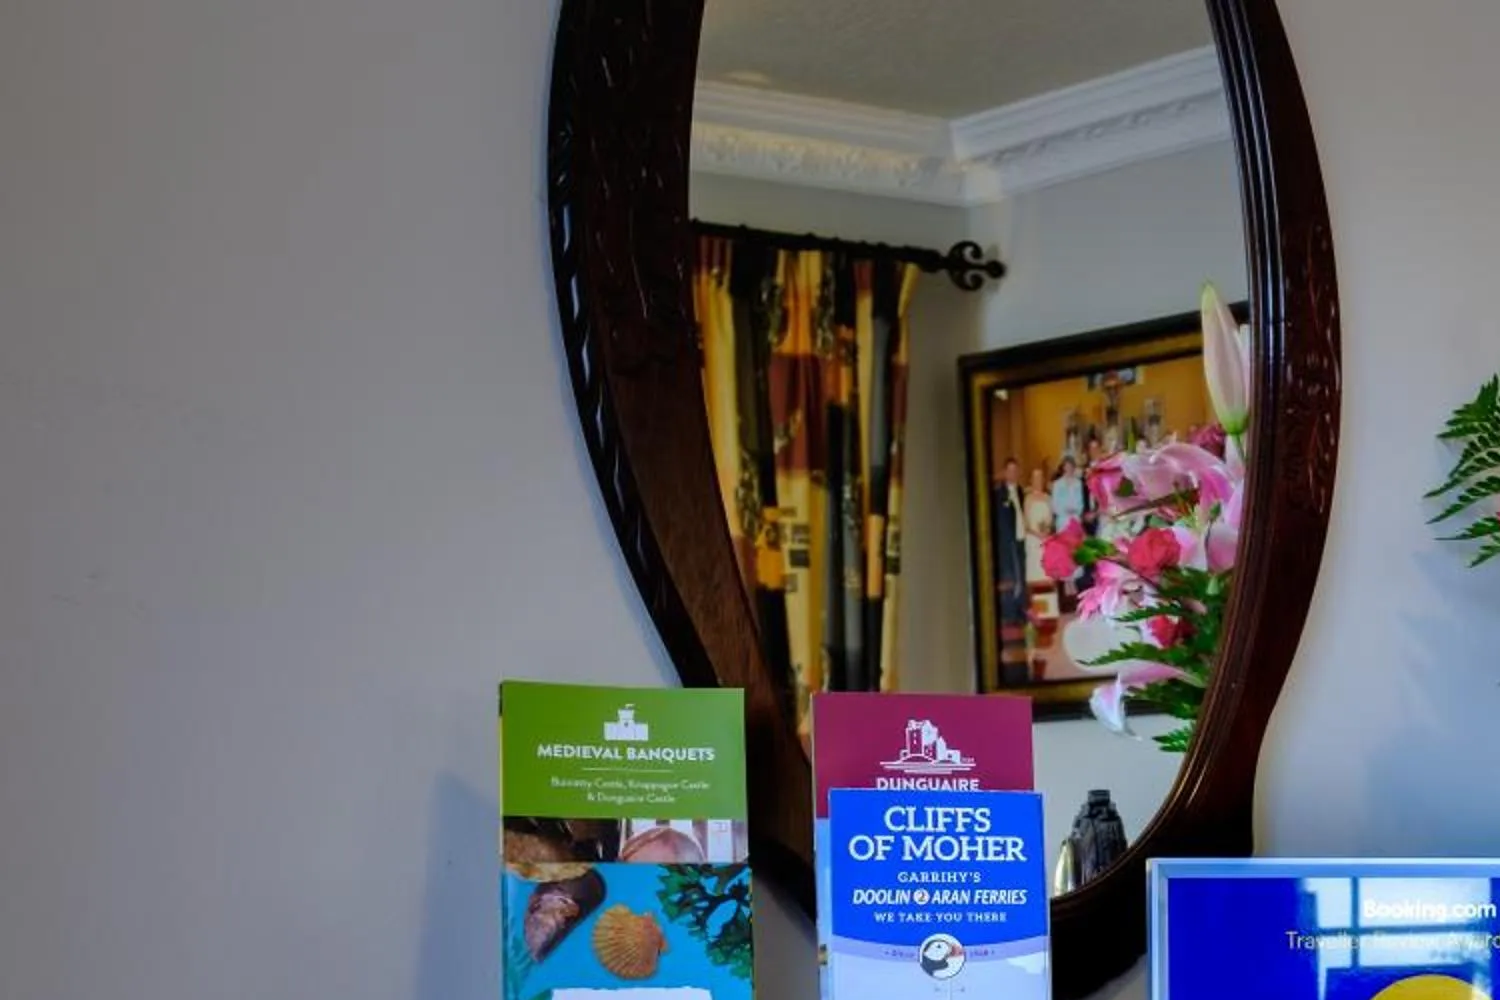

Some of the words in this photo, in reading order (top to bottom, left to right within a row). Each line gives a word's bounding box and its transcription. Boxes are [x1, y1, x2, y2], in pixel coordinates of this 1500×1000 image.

[537, 744, 623, 760] MEDIEVAL
[626, 746, 715, 763] BANQUETS
[876, 777, 980, 791] DUNGUAIRE
[884, 805, 991, 832] CLIFFS
[849, 834, 895, 861] OF
[902, 834, 1028, 861] MOHER
[897, 871, 982, 883] GARRIHY'S
[853, 889, 910, 905] DOOLIN
[931, 889, 971, 905] ARAN
[974, 889, 1028, 905] FERRIES
[873, 911, 895, 922] WE
[900, 911, 931, 922] TAKE
[935, 911, 962, 922] YOU
[968, 911, 1007, 922] THERE
[1363, 899, 1497, 921] Booking.com
